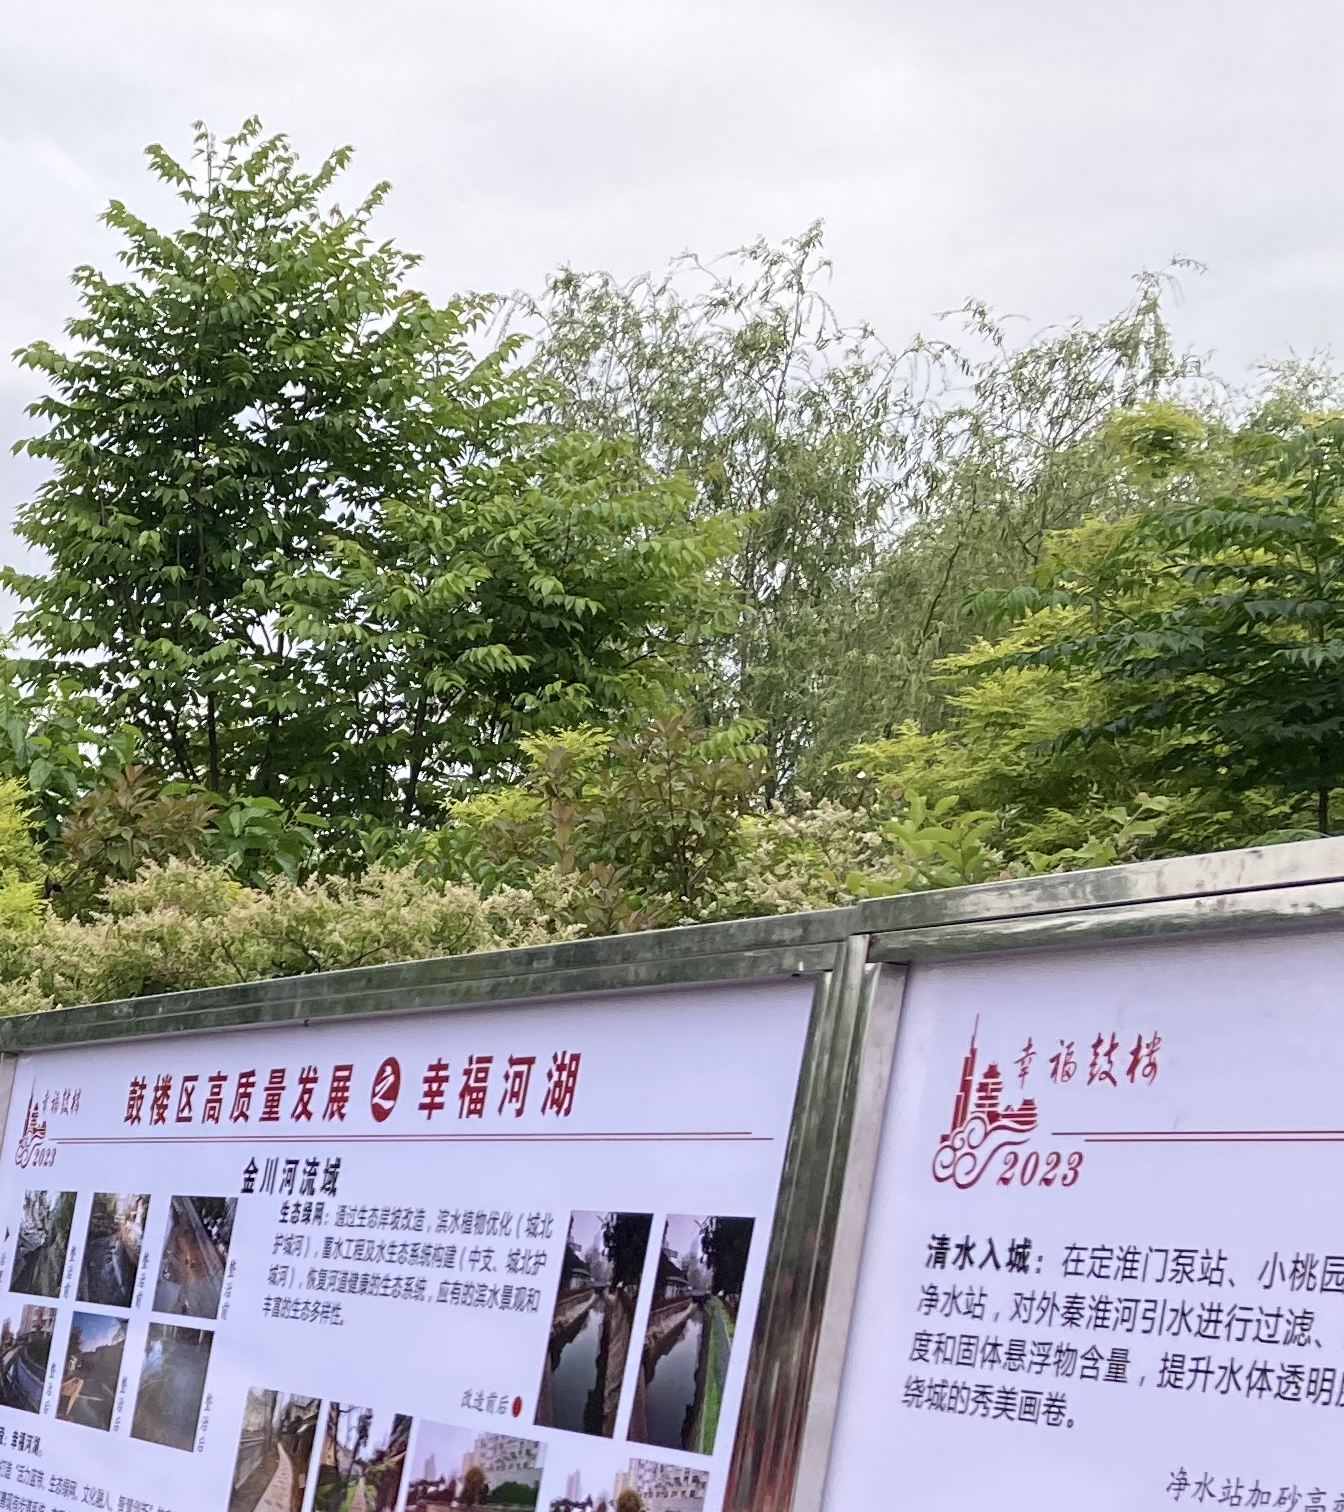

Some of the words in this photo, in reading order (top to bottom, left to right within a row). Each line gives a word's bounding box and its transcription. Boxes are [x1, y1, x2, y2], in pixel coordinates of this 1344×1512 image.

[240, 1156, 342, 1198] 金川河流域
[996, 1150, 1084, 1188] 2023
[909, 1331, 1344, 1408] 度和固体悬浮物含量，提升水体透明
[901, 1377, 1074, 1429] 绕城的秀美画卷。
